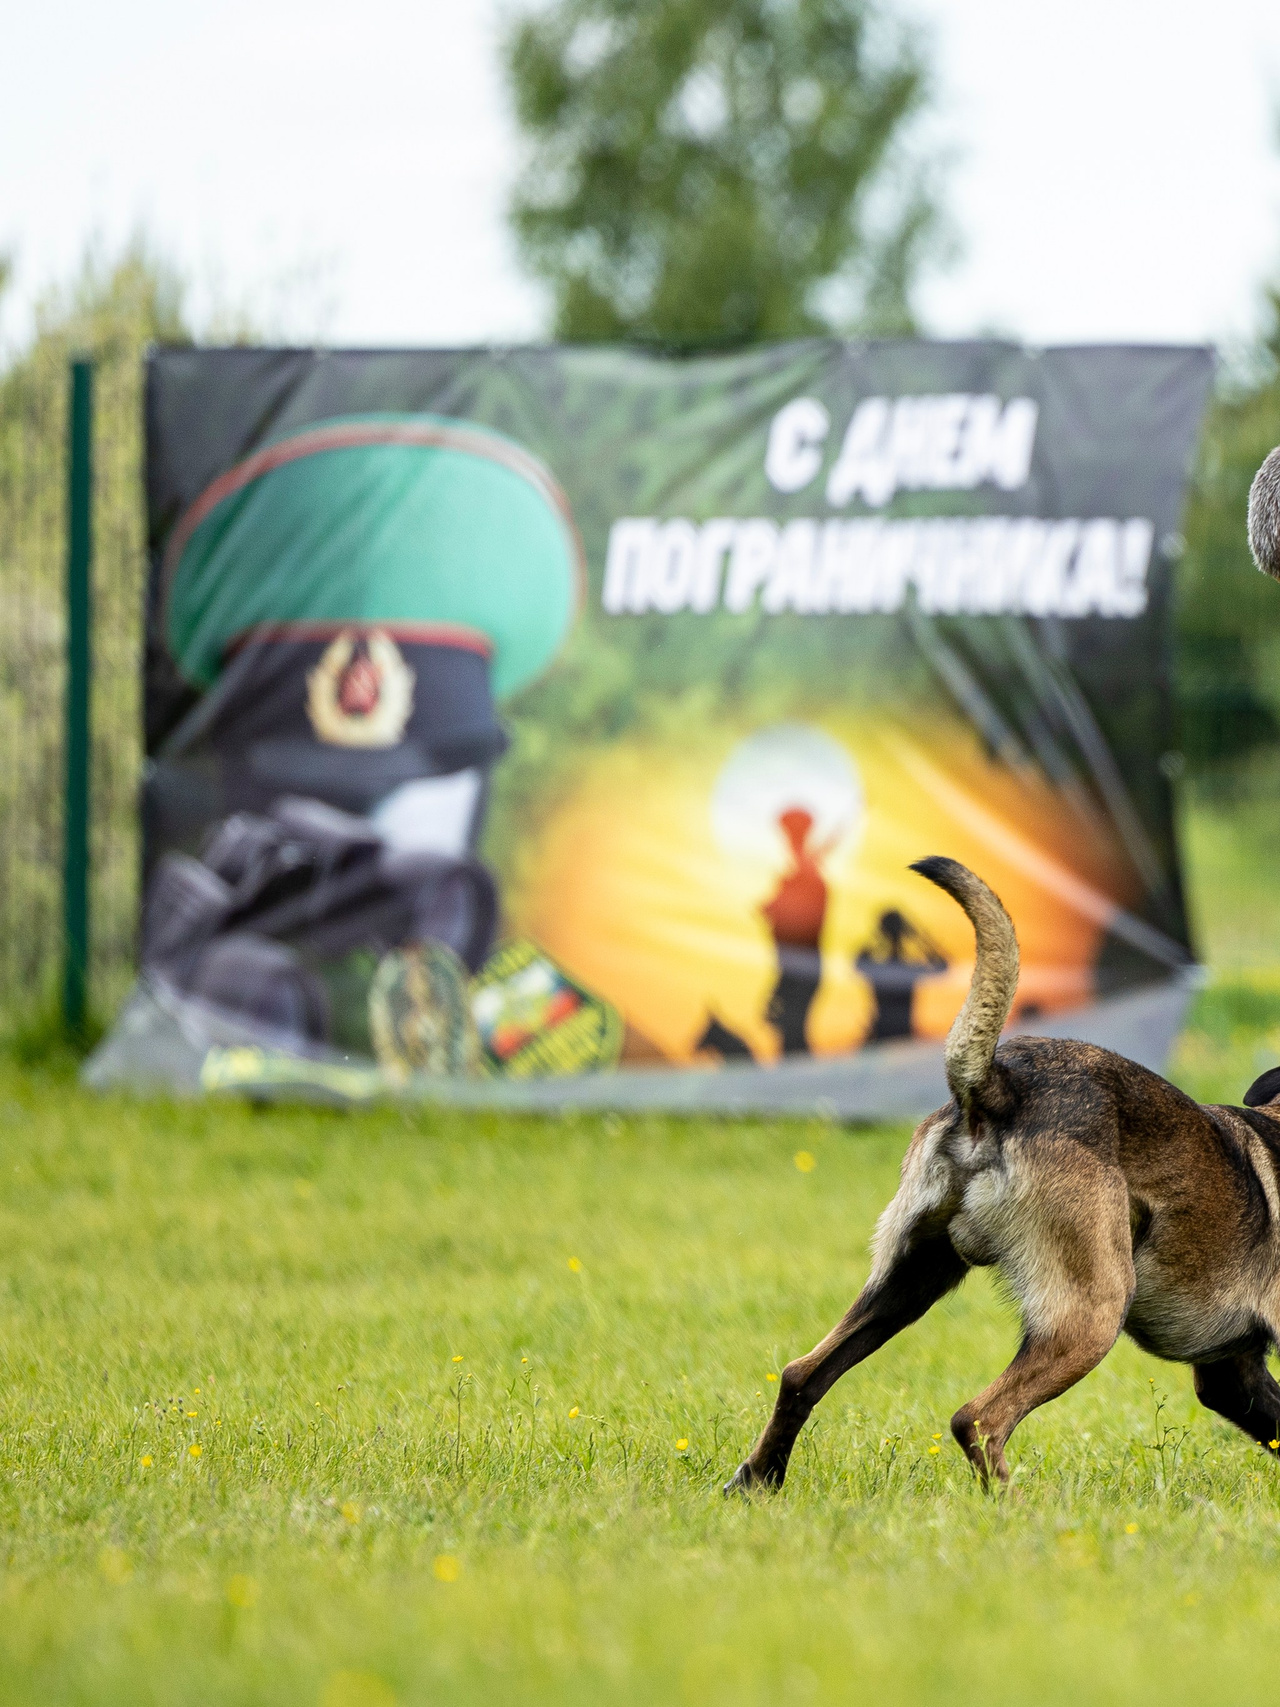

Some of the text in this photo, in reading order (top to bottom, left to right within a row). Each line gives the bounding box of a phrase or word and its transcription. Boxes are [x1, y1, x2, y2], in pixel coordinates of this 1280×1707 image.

[765, 393, 1040, 508] С ДНЕМ
[602, 515, 1154, 618] ПОГРАНИЧНИКА!
